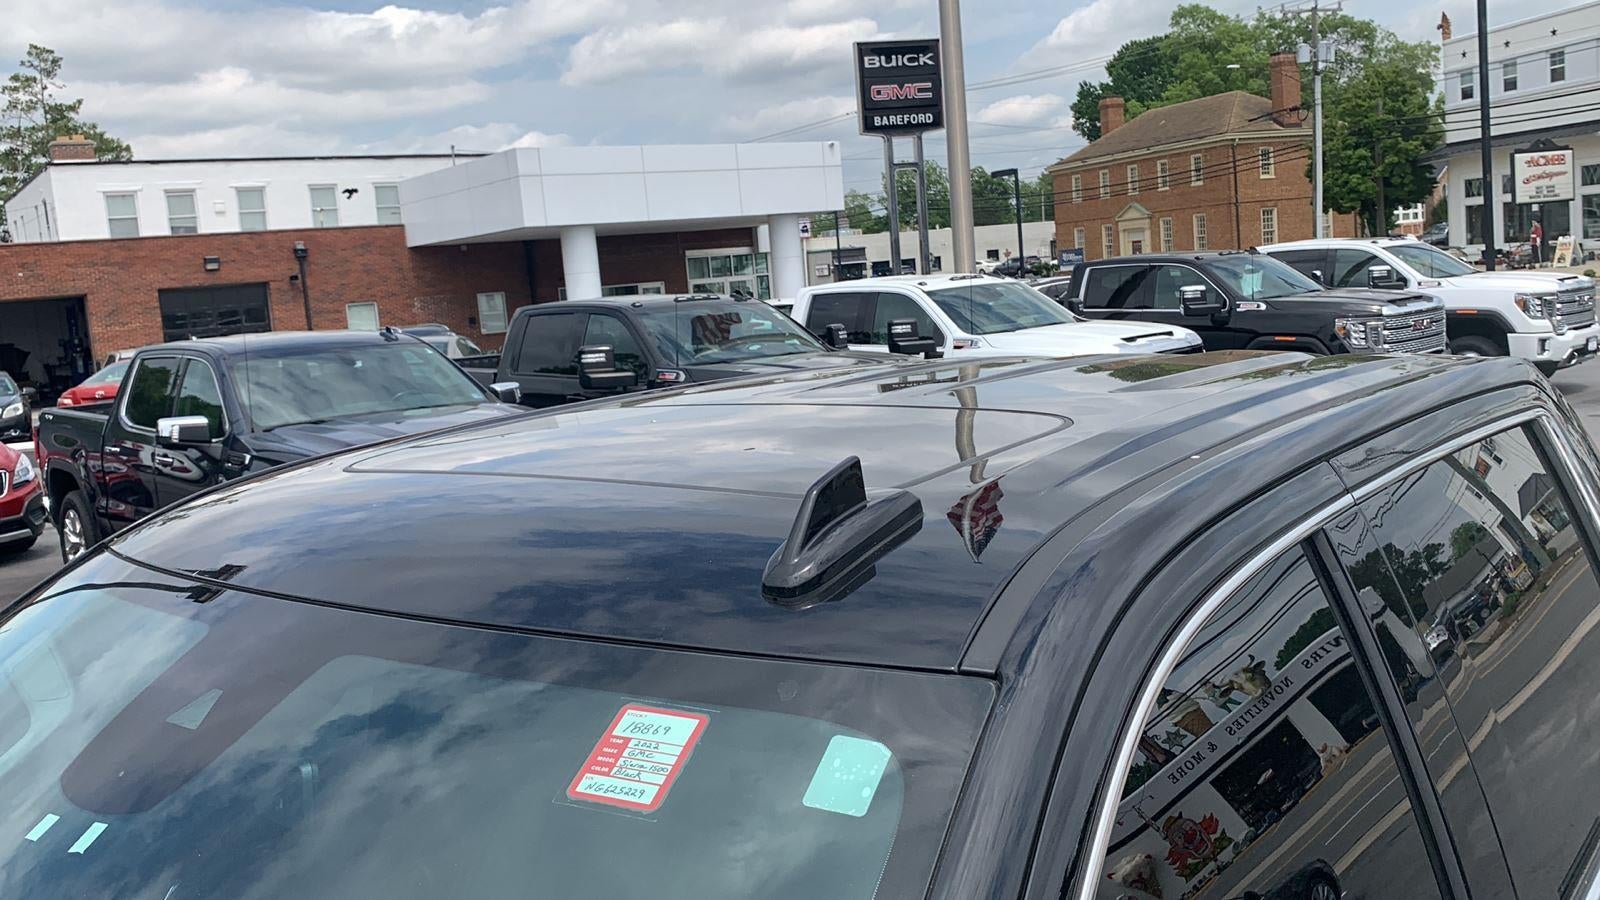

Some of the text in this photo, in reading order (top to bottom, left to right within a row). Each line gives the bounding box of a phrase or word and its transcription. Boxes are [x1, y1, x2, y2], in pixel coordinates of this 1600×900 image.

[863, 53, 935, 68] BUICK
[870, 83, 933, 101] GMC
[873, 113, 934, 126] BAREFORD
[622, 721, 671, 735] 18869
[633, 740, 660, 750] 2022
[627, 749, 656, 759] GMC
[613, 767, 641, 780] Black
[648, 765, 669, 773] 1500
[584, 781, 646, 799] NG625229
